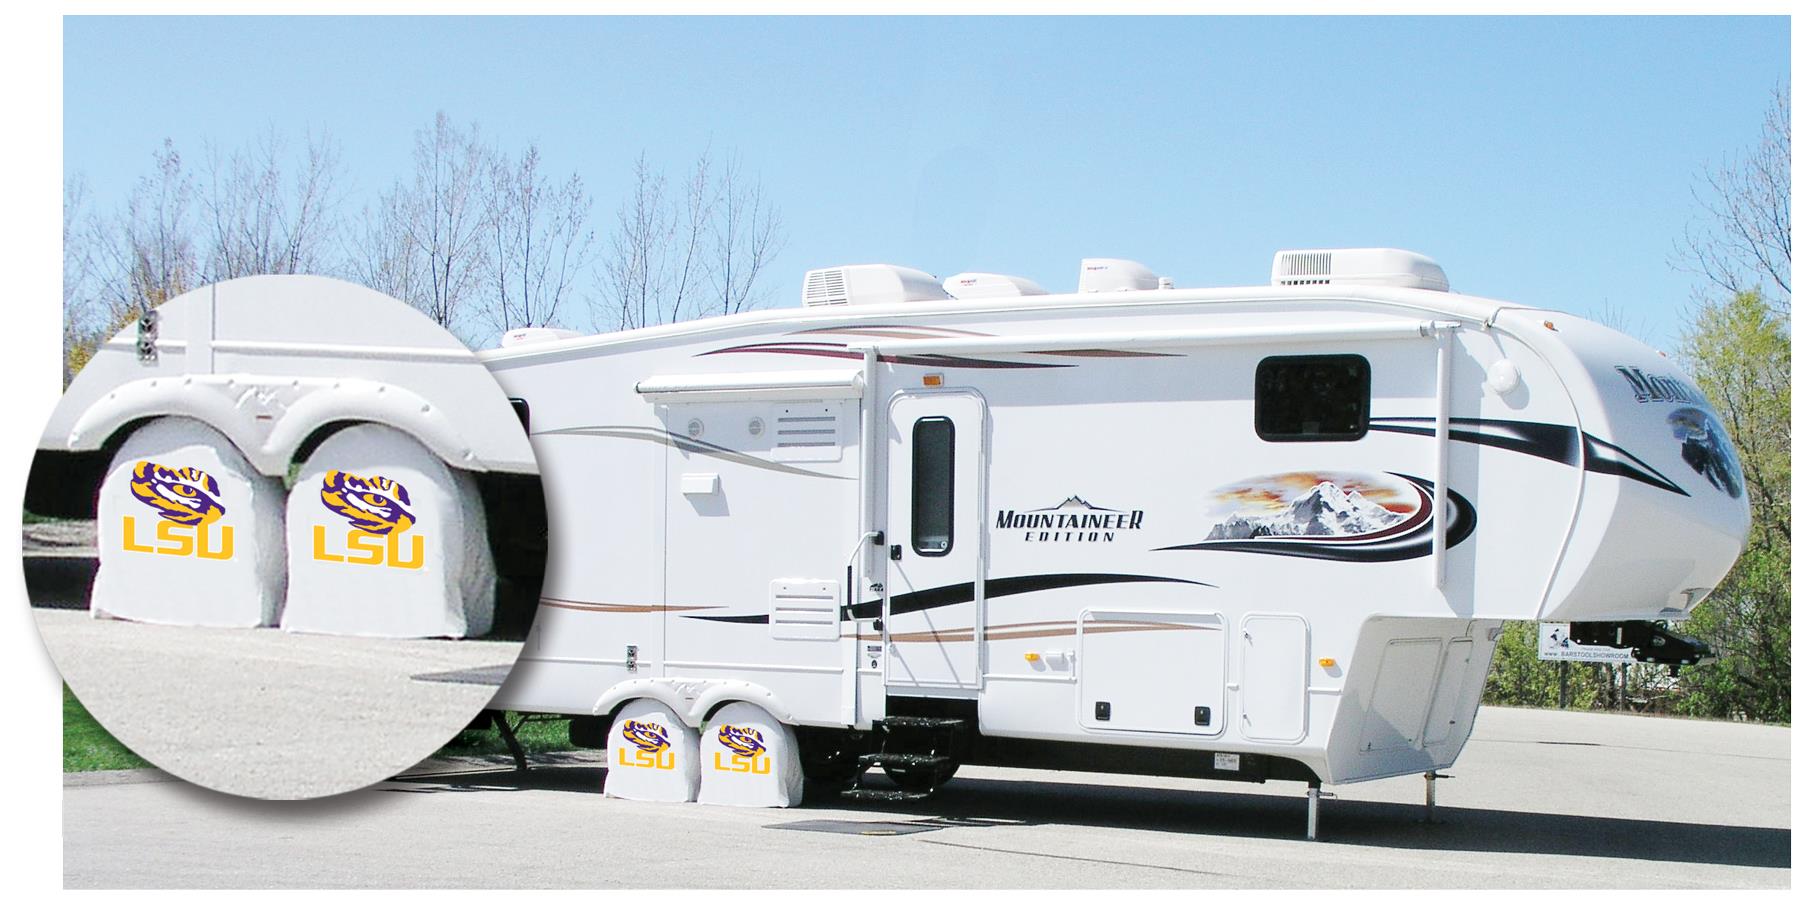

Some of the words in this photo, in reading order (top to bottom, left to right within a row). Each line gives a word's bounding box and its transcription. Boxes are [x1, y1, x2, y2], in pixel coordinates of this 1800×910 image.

[996, 510, 1144, 530] MOUNTAINEER
[123, 516, 234, 561] LSU
[313, 525, 425, 570] LSU
[1025, 531, 1115, 543] EDITION
[618, 747, 675, 771] LSU
[714, 751, 771, 775] LSU
